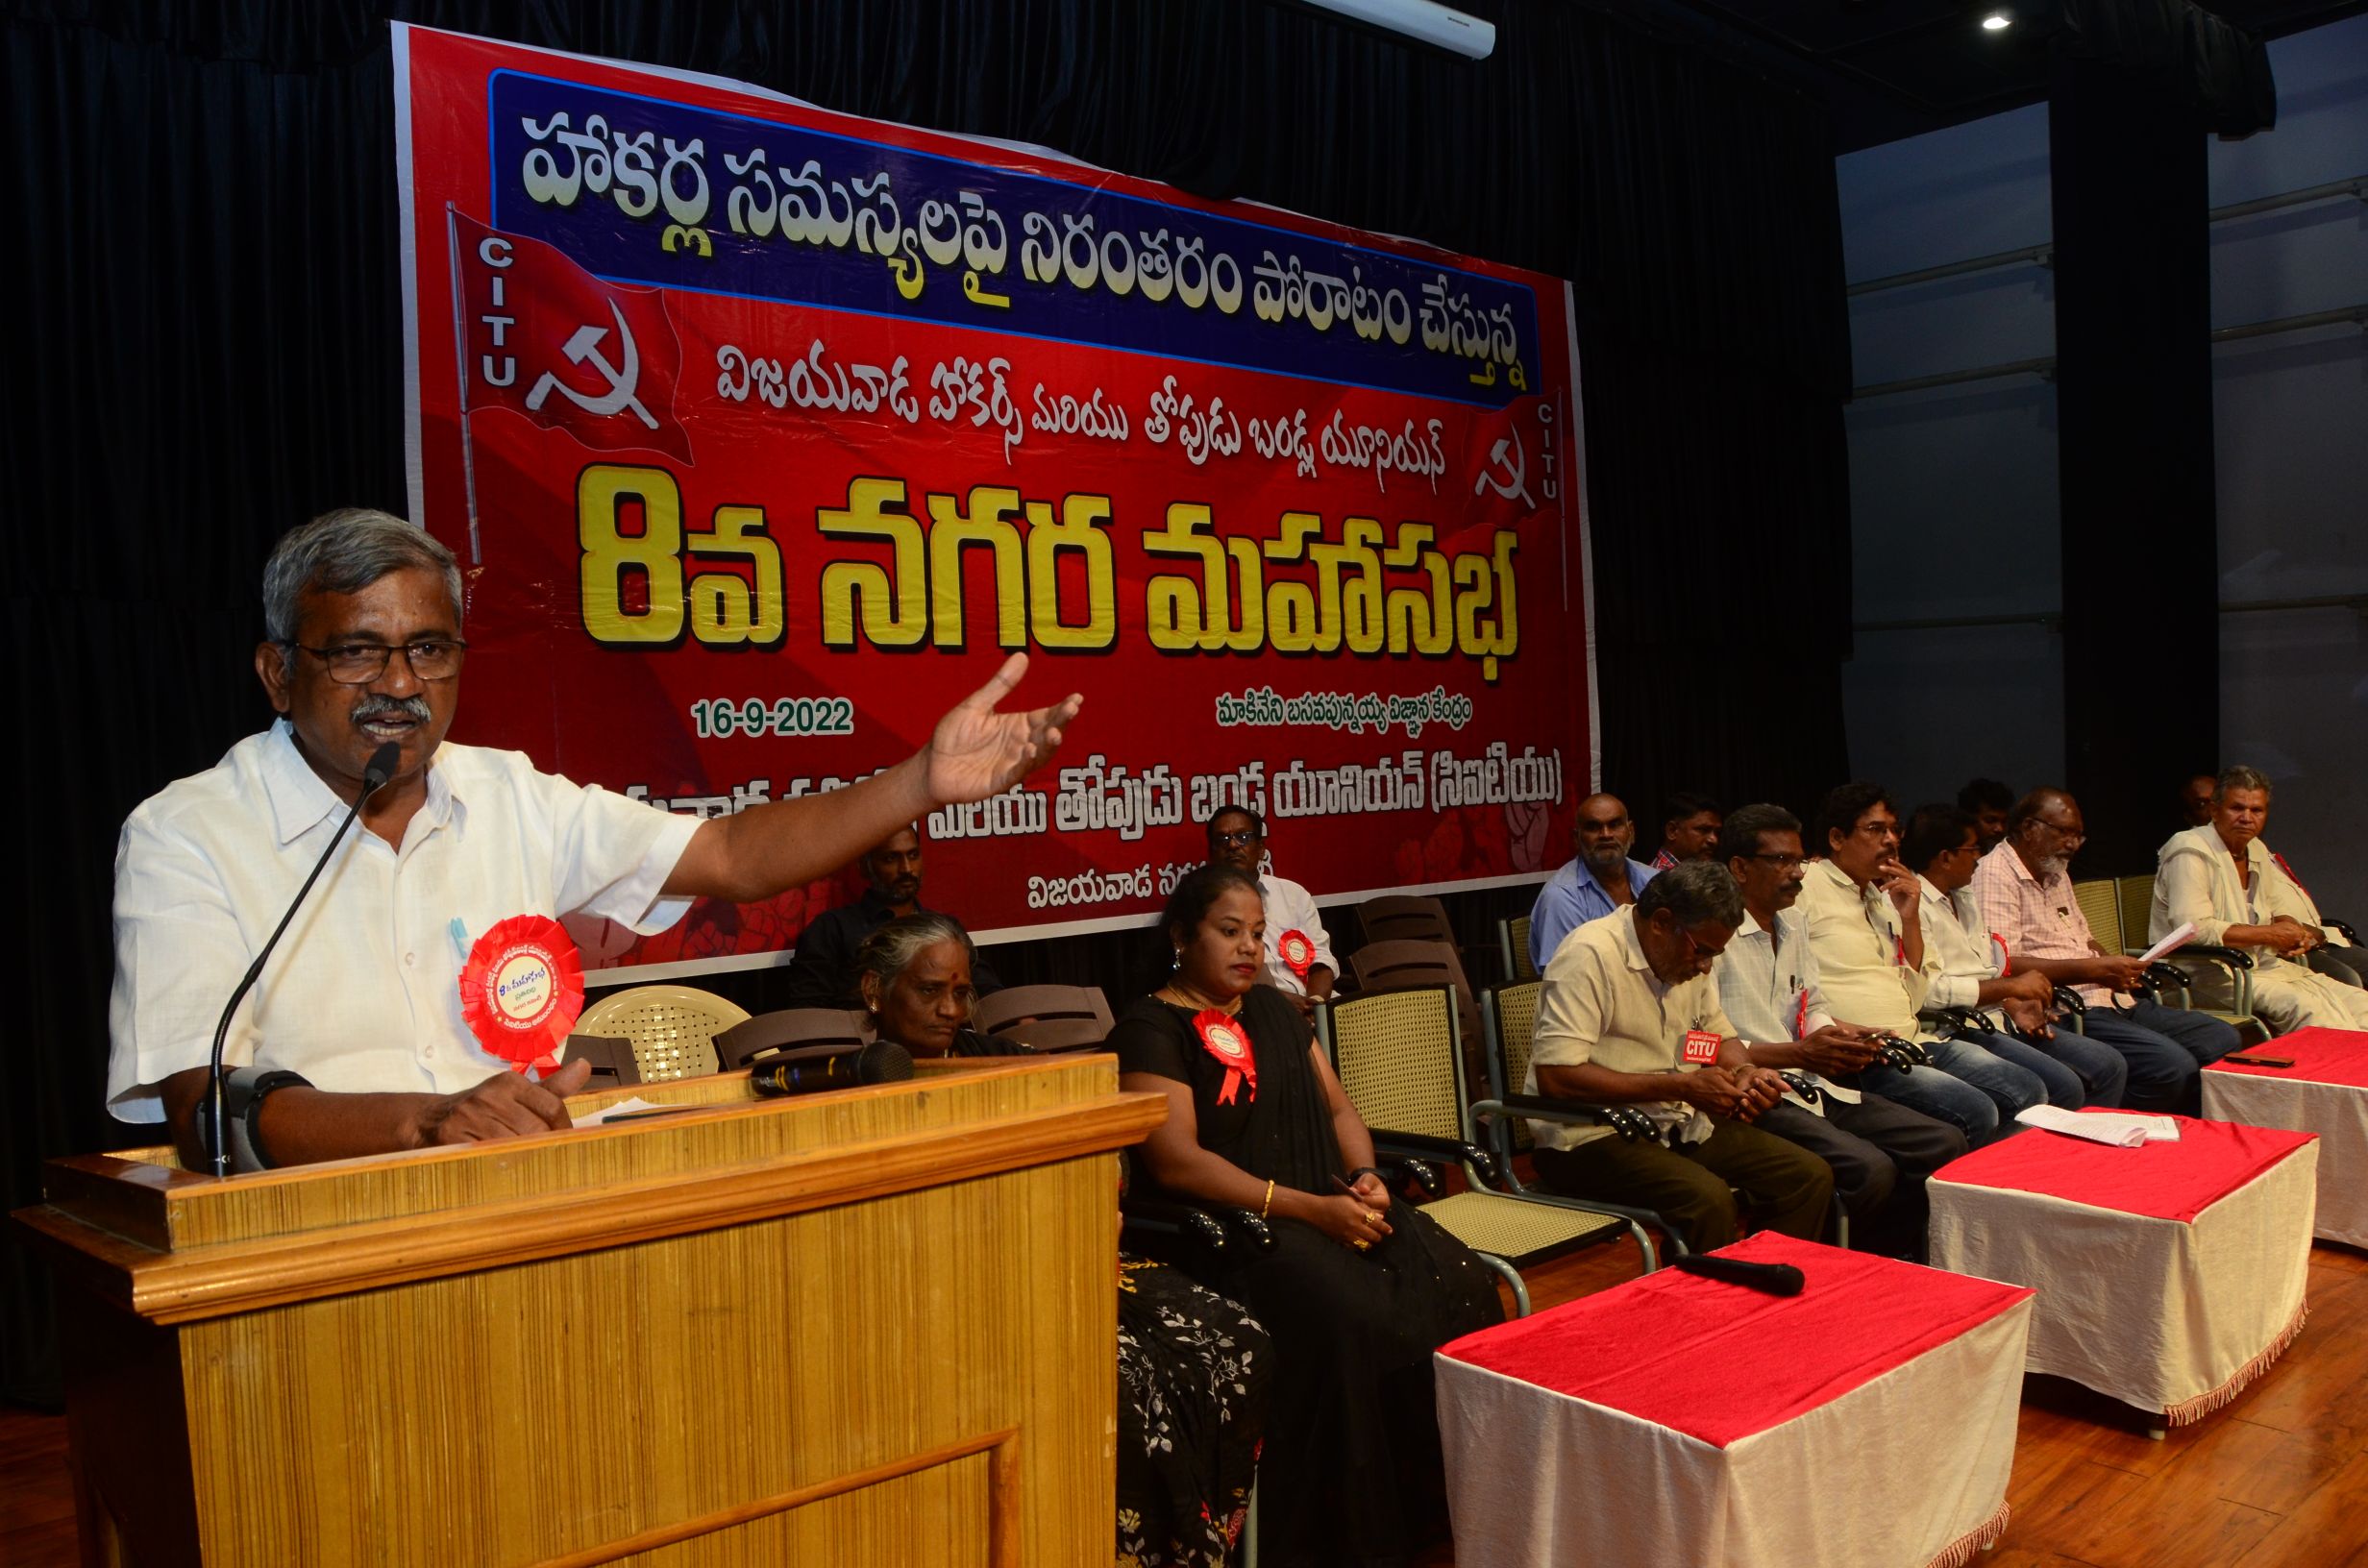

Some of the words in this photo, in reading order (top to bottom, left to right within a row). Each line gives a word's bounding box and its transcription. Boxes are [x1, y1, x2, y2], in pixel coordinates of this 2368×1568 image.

[522, 111, 712, 257] హాకర్ల
[724, 148, 1010, 307] సమస్యలపై
[1022, 209, 1244, 315] నిరంతరం
[1253, 250, 1412, 345] పోరాటం
[1419, 274, 1526, 391] చేస్తున్న
[480, 237, 516, 386] CITU
[716, 339, 919, 423] విజయవాడ
[1031, 382, 1129, 440] మరియు
[1145, 375, 1242, 465] తోపుడు
[1248, 408, 1318, 478] బండ్ల
[1321, 408, 1445, 496] యూనియన్
[1538, 404, 1557, 499] CITU
[579, 464, 781, 647] 8వ
[817, 478, 1117, 649] నగర
[1143, 502, 1517, 681] మహాసభ
[692, 698, 852, 737] 16-9-2022
[1431, 685, 1472, 730] కేంద్రం
[1056, 755, 1183, 841] తోపుడు
[1272, 751, 1424, 818] యూనియన్
[1028, 863, 1153, 909] విజయవాడ
[1687, 1040, 1716, 1057] CITU
